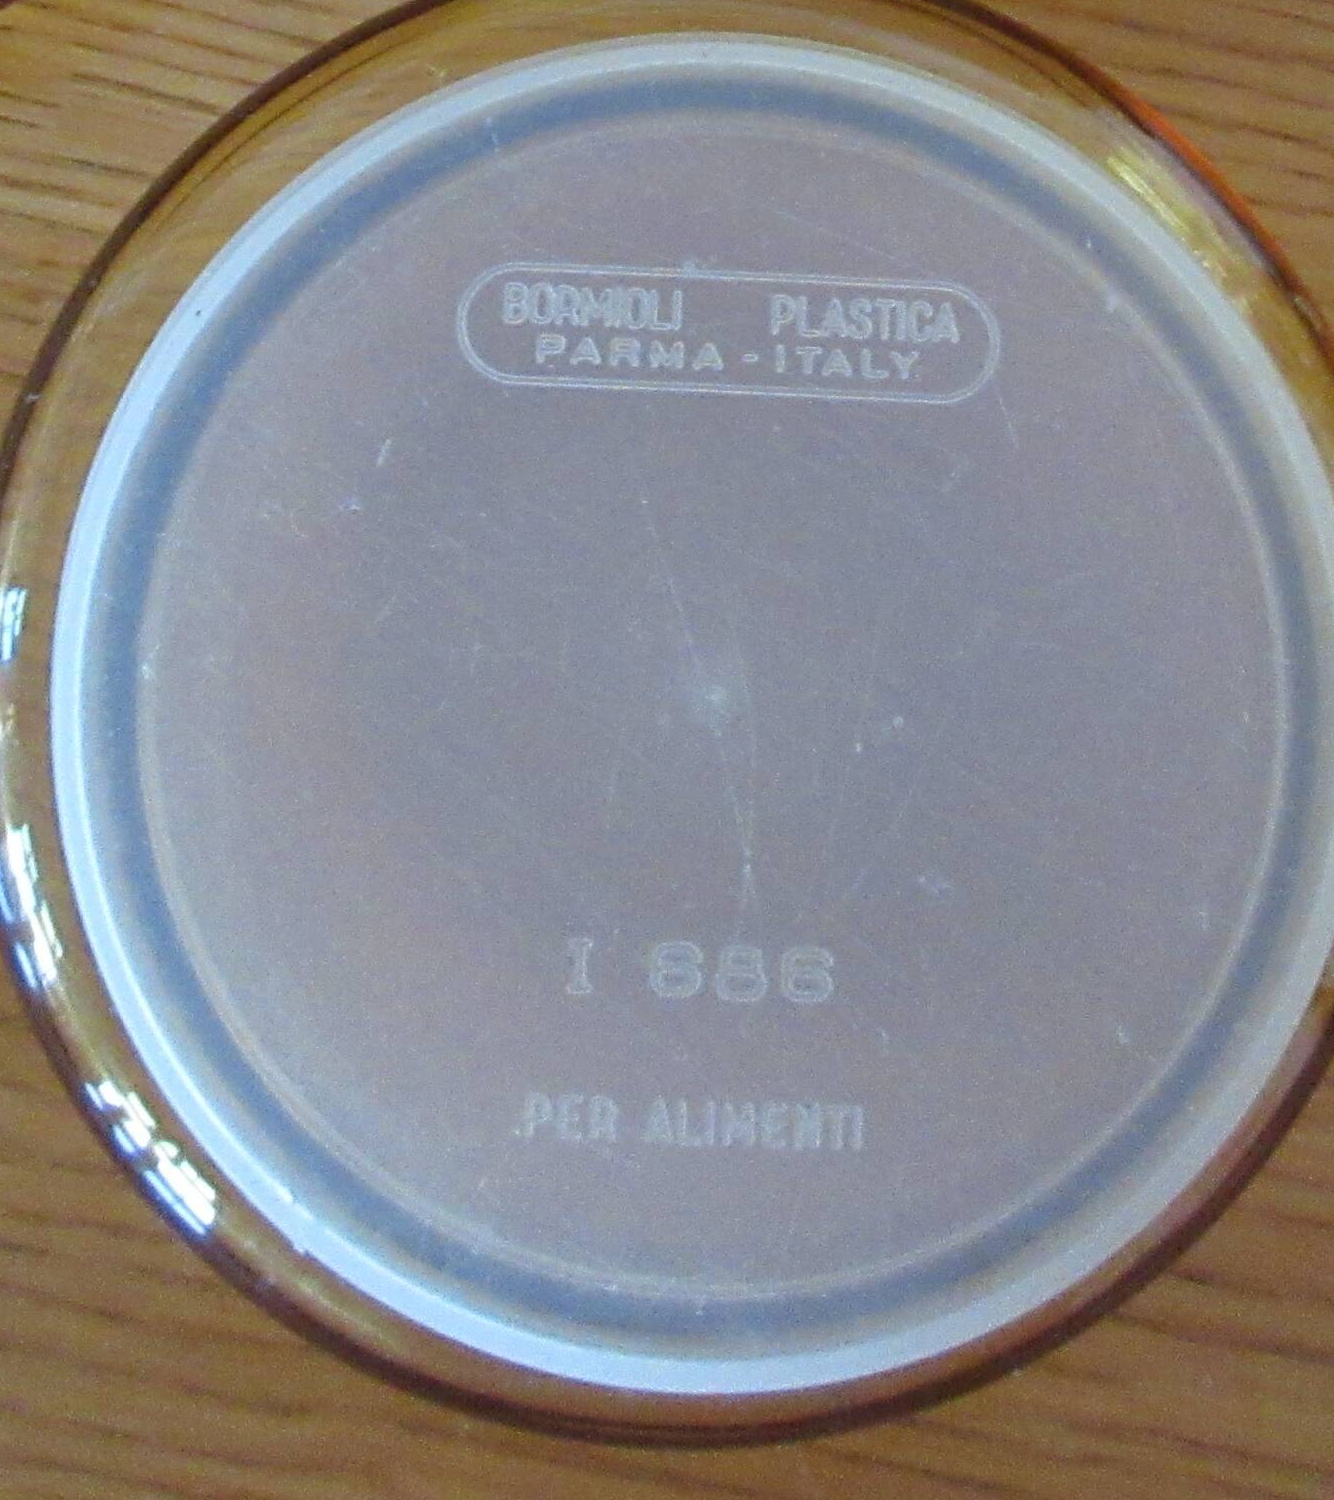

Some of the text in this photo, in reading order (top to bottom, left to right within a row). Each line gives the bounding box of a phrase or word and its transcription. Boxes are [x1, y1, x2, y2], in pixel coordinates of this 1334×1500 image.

[500, 280, 961, 345] BORMIOLI PLASTICA
[534, 331, 726, 372] PARMA
[773, 342, 922, 382] ITALY
[522, 1091, 866, 1153] PER ALIMENTI
